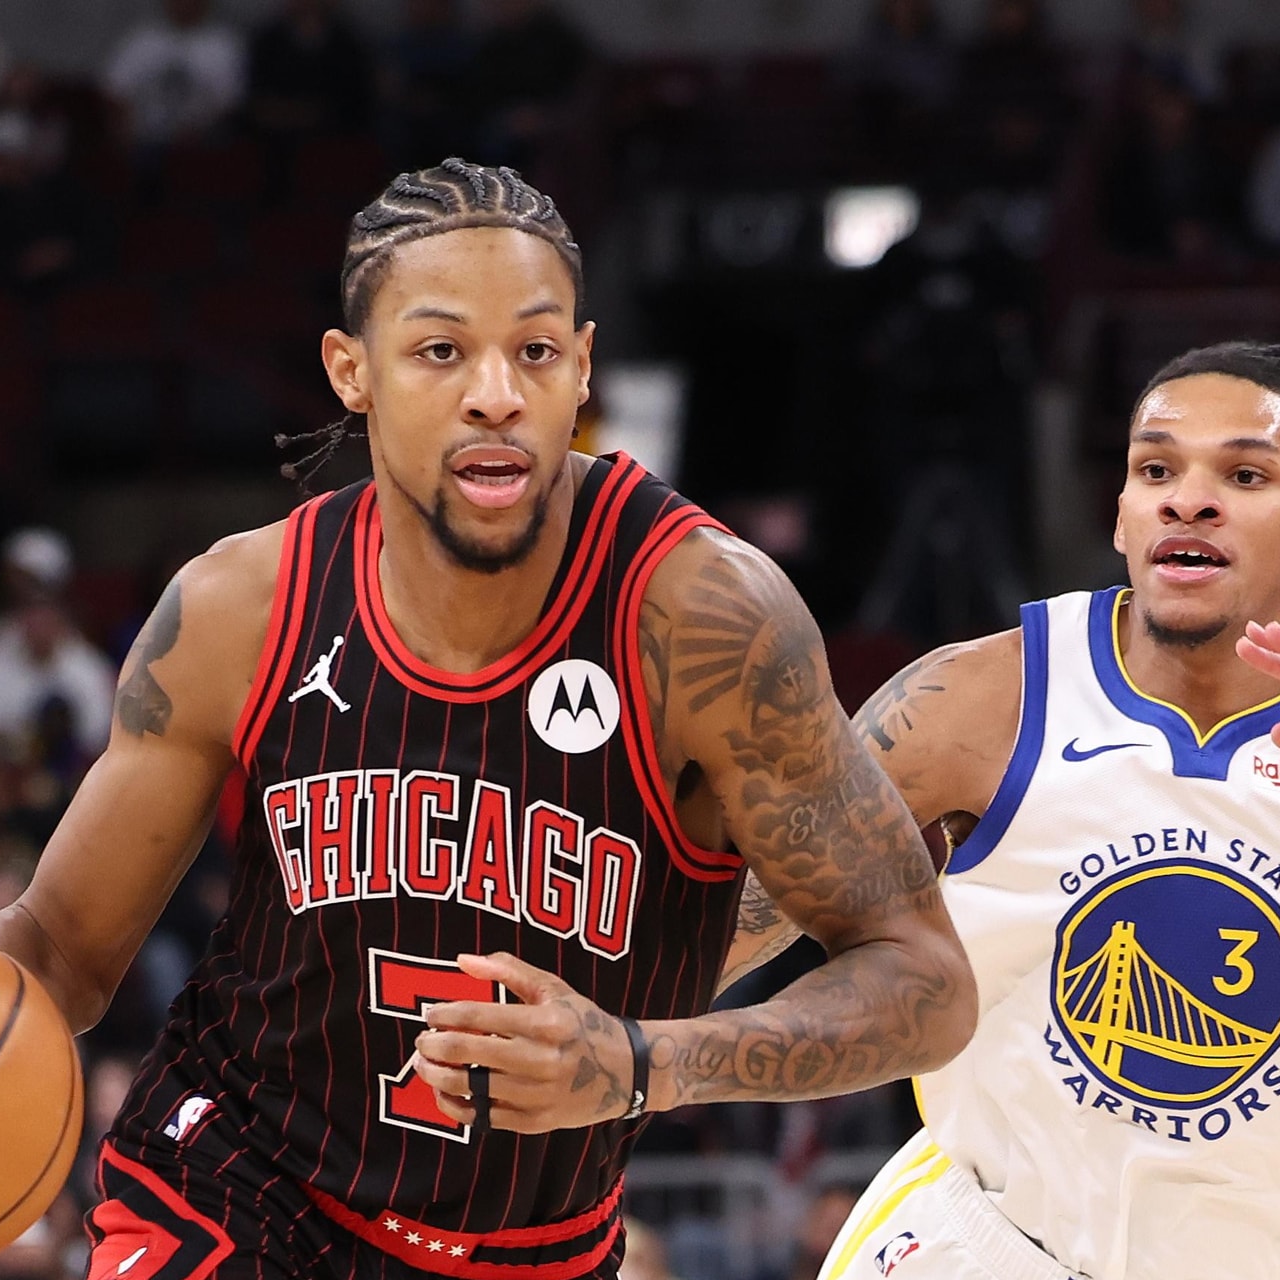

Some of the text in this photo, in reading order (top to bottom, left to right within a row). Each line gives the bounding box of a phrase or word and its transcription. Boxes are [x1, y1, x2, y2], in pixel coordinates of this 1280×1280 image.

[263, 768, 642, 962] CHICAGO
[1059, 827, 1208, 895] GOLDEN
[1212, 927, 1260, 997] 3
[368, 947, 507, 1145] 7
